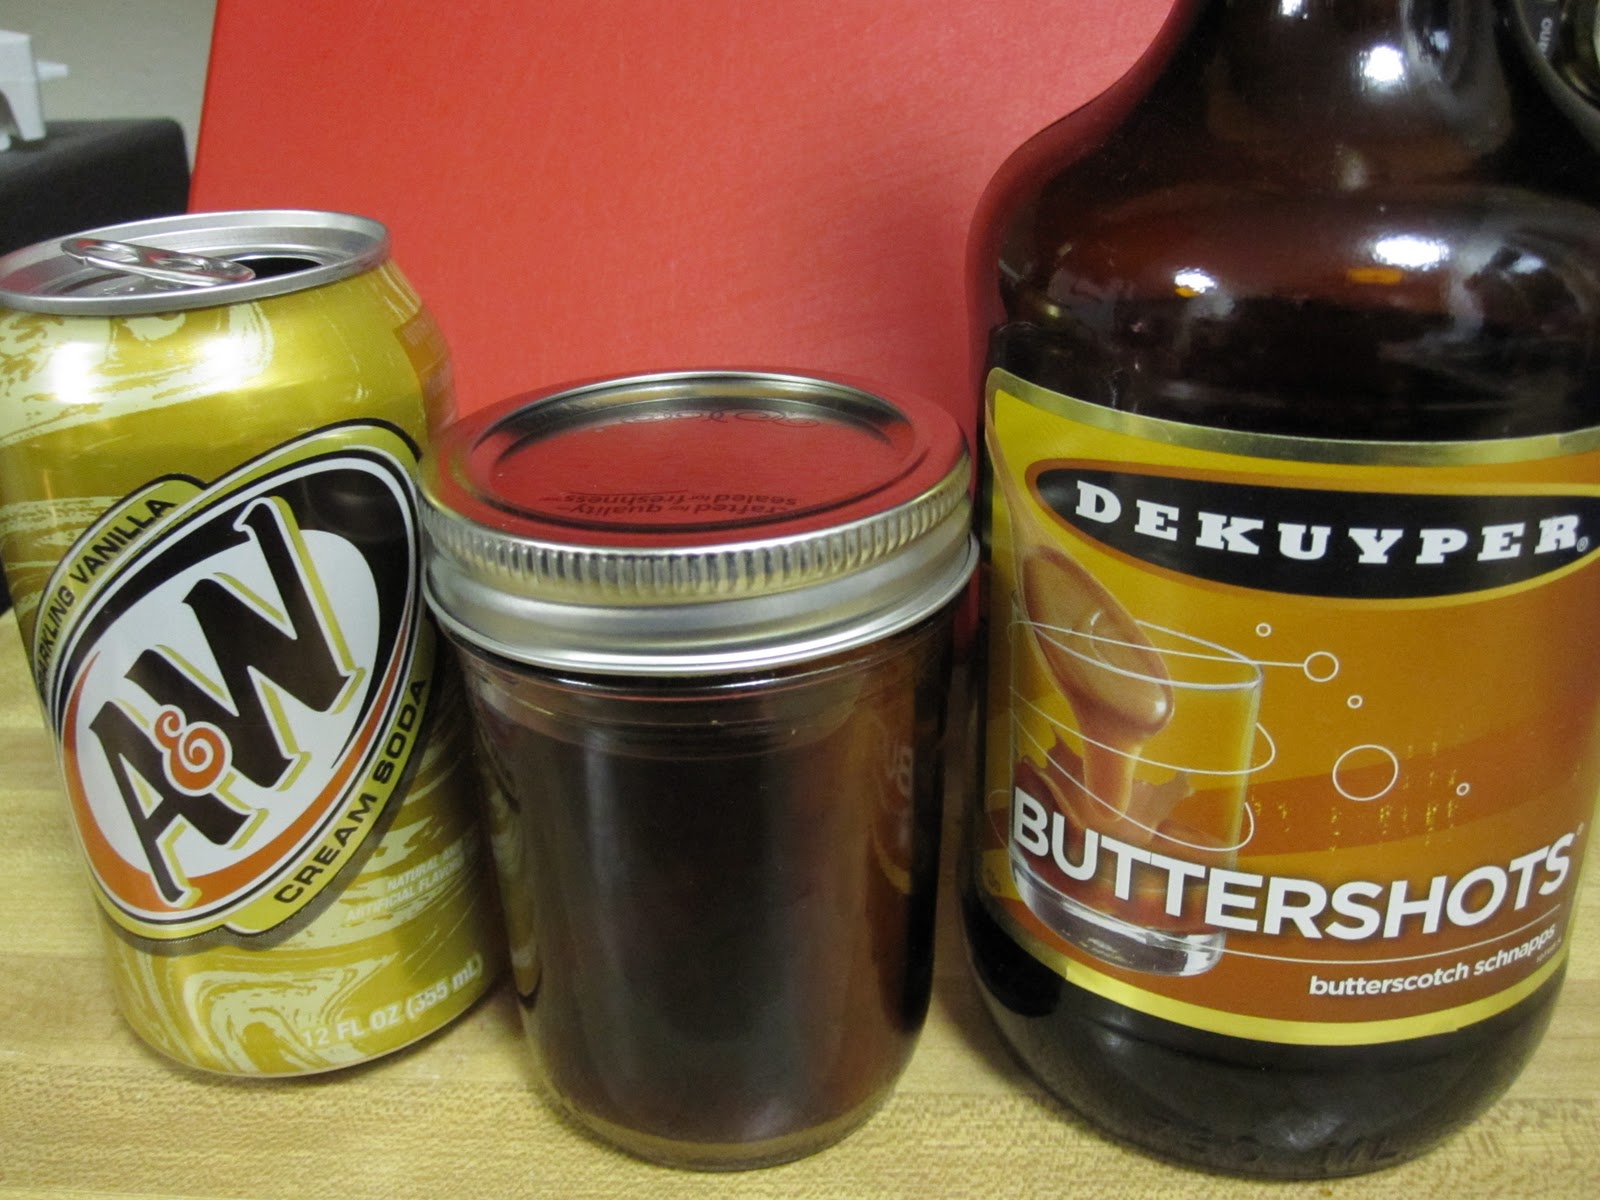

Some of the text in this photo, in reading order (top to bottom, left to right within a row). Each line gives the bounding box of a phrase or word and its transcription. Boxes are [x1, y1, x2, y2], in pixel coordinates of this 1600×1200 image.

[564, 495, 686, 506] freshness
[1075, 480, 1580, 565] DEKUYPER
[36, 499, 177, 707] ARKLING VANILLA
[89, 494, 366, 908] A&W
[273, 679, 426, 905] CREAM SODA
[386, 857, 441, 890] NATURAL
[1013, 785, 1573, 941] BUTTERSHOTS
[303, 953, 483, 1048] 12 FL OZ (355 mL)
[1309, 962, 1469, 998] butterscotch
[1473, 924, 1556, 977] schnapps
